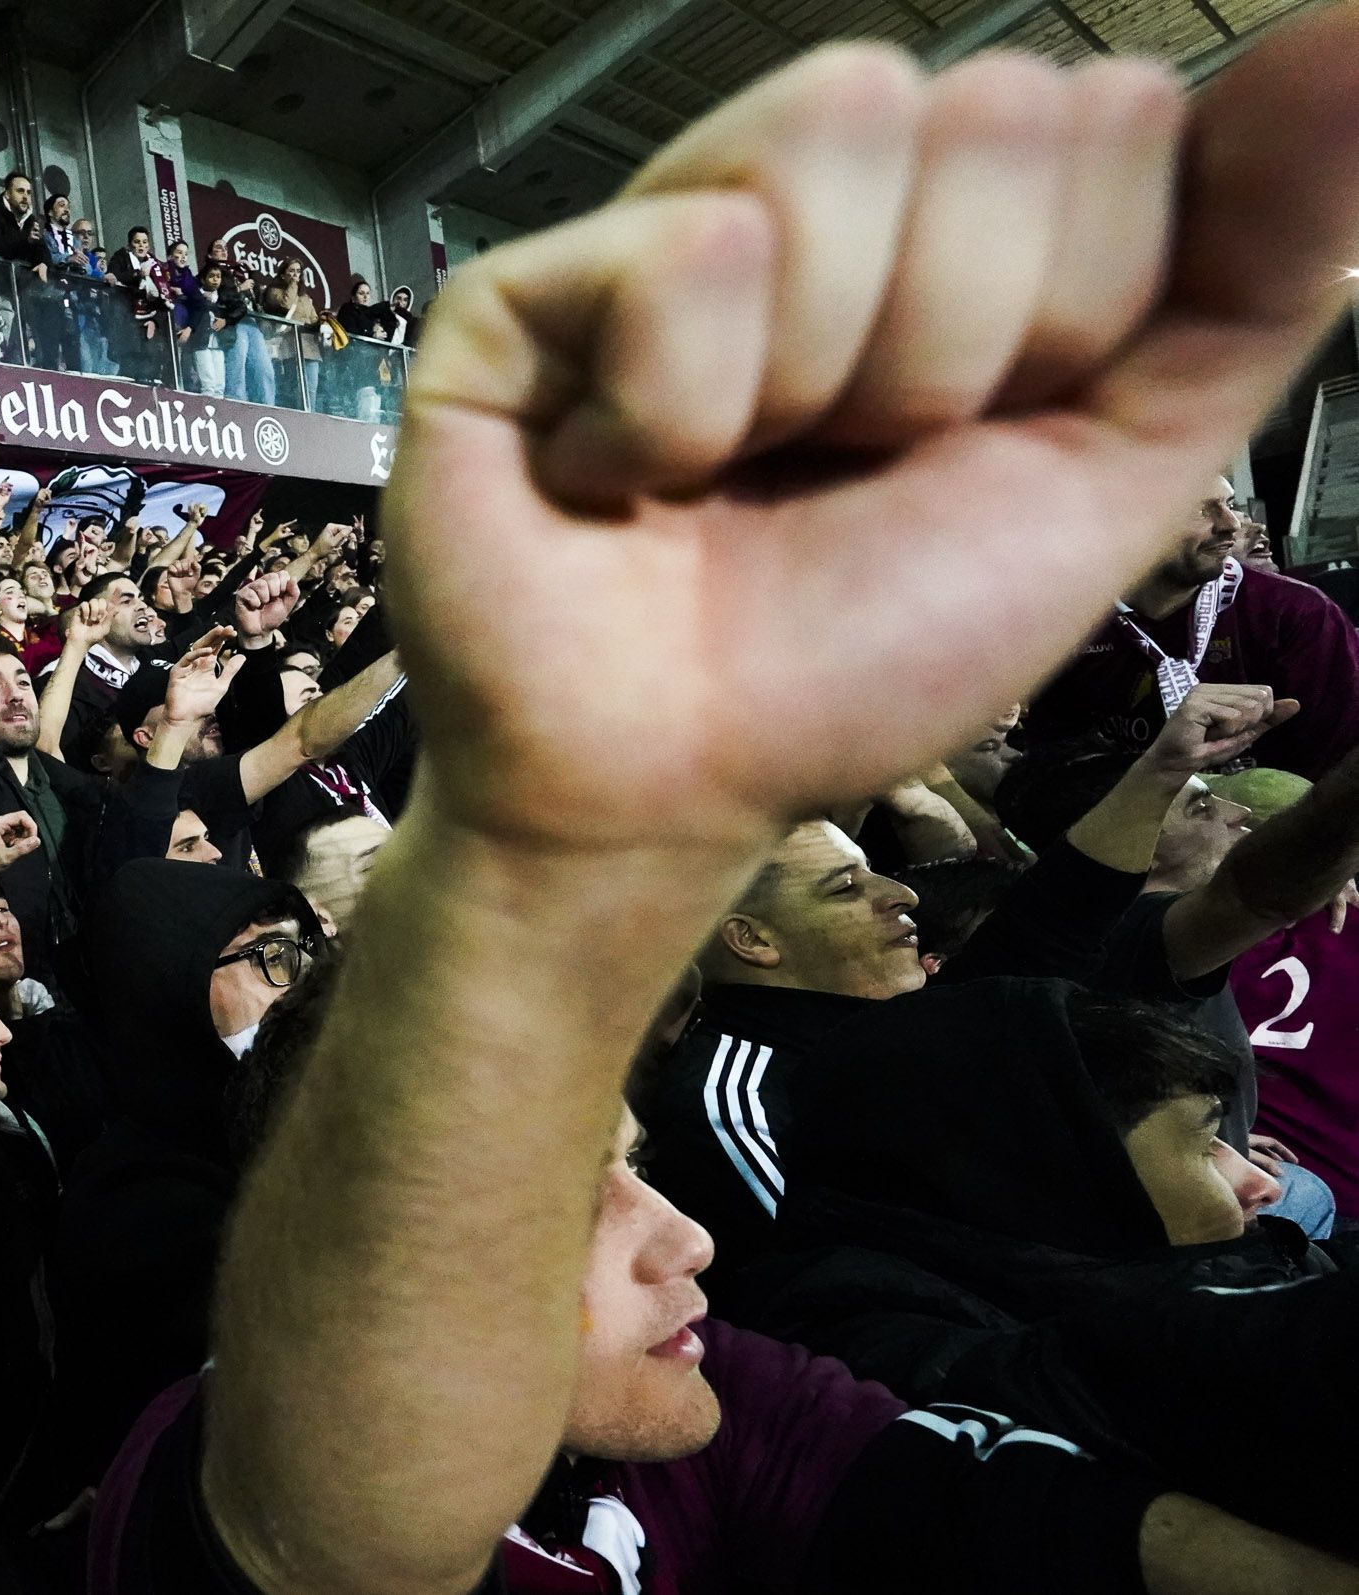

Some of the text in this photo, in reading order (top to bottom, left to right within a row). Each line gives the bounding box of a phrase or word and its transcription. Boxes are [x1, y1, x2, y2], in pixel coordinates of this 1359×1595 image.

[232, 240, 316, 289] Estra
[96, 388, 248, 461] Galicia
[370, 431, 396, 481] E
[1249, 955, 1315, 1050] 2
